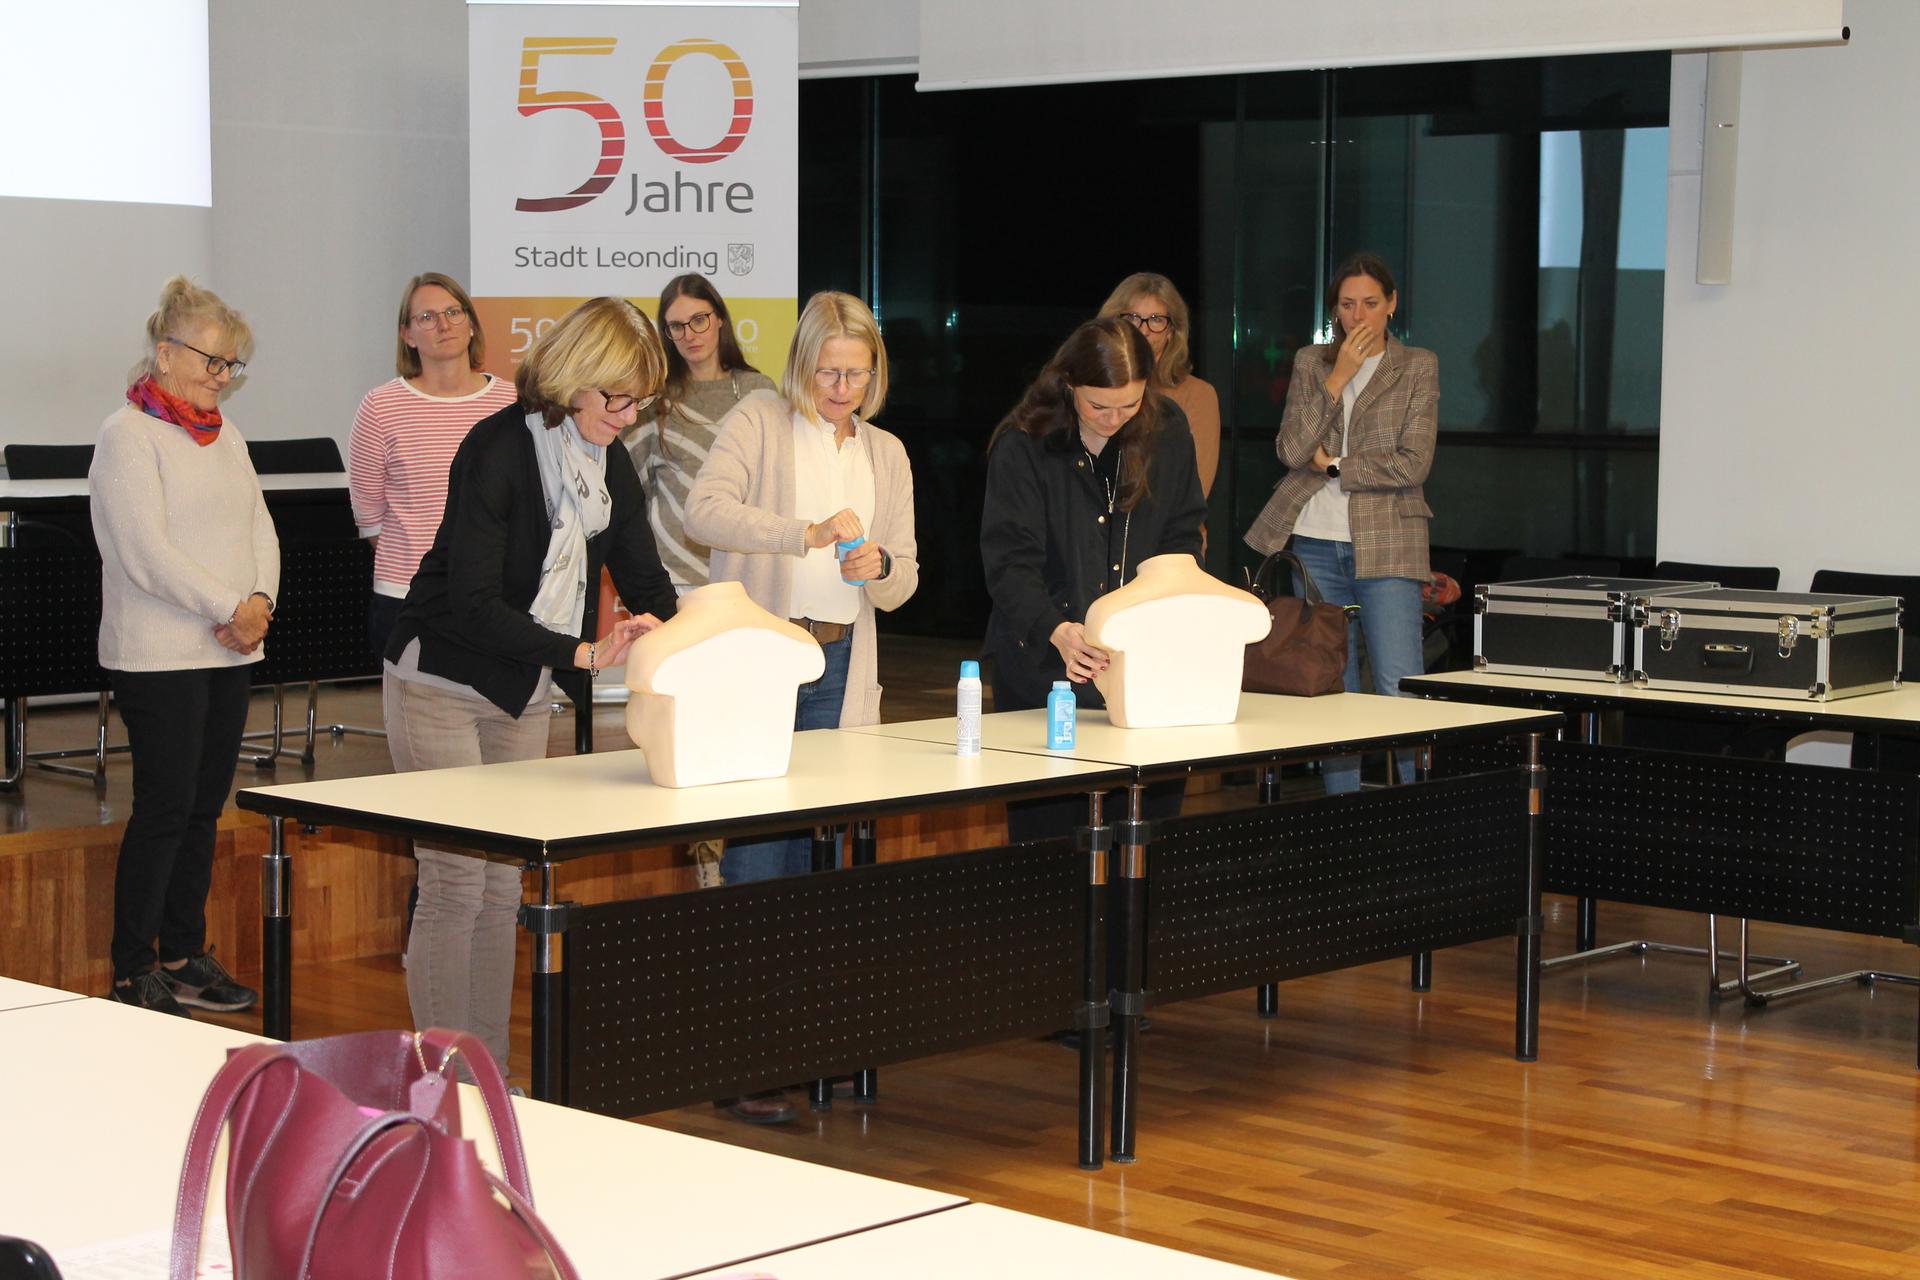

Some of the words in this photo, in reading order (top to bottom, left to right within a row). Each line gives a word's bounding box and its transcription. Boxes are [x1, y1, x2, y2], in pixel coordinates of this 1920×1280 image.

[515, 37, 753, 212] 50
[625, 171, 753, 216] Jahre
[515, 246, 587, 268] Stadt
[598, 246, 718, 275] Leonding
